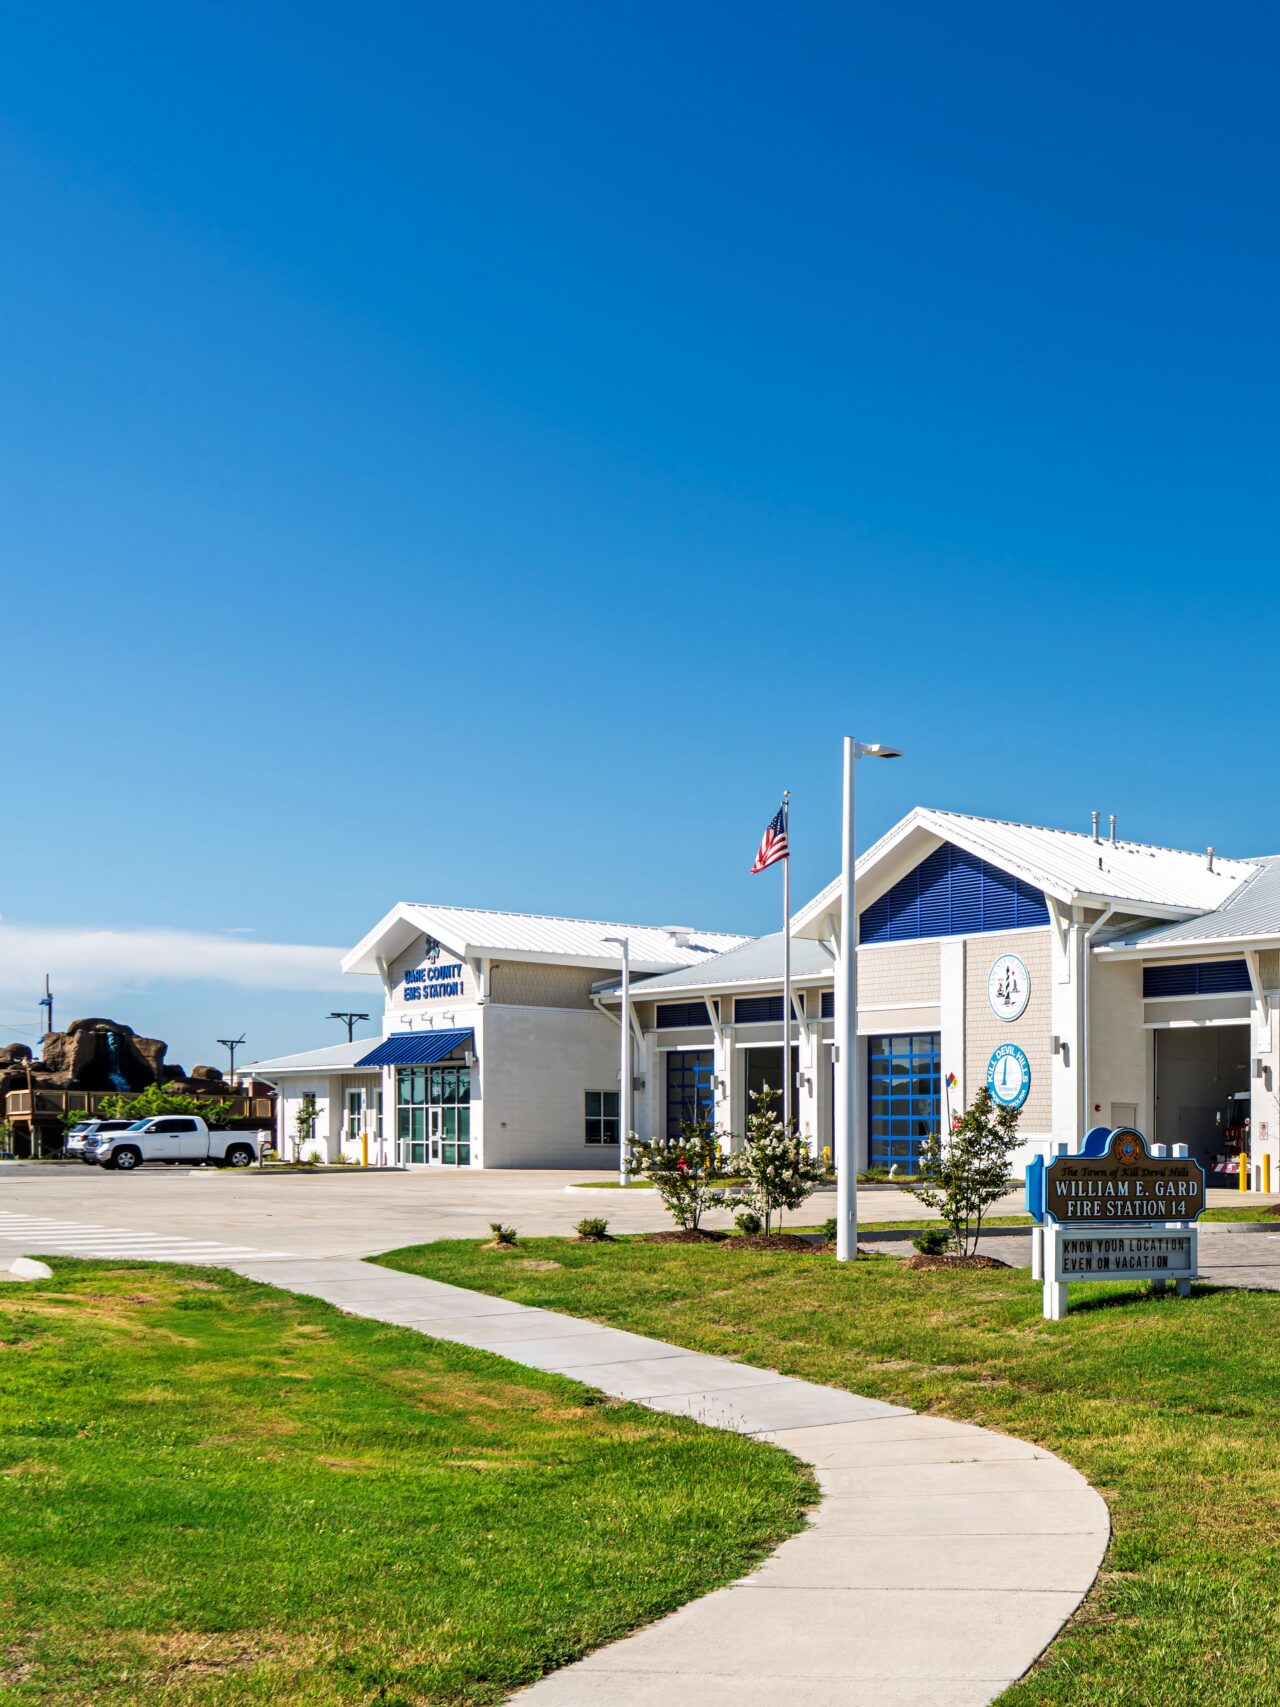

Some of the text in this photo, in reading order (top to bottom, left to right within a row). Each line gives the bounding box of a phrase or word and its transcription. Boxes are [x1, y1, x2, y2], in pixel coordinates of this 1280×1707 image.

[405, 964, 462, 984] DARE COUNTY
[404, 981, 464, 1001] EMS STATION 1
[987, 1045, 1029, 1083] KILL DEVIL HILLS
[1062, 1166, 1189, 1179] The Town of Kill Devil Hills
[1056, 1181, 1198, 1196] WILLIAM E. GARD
[1067, 1200, 1186, 1216] FIRE STATION 14
[1064, 1238, 1185, 1253] KNOW YOUR LOCATION
[1064, 1255, 1168, 1270] EVEN ON VACATION
